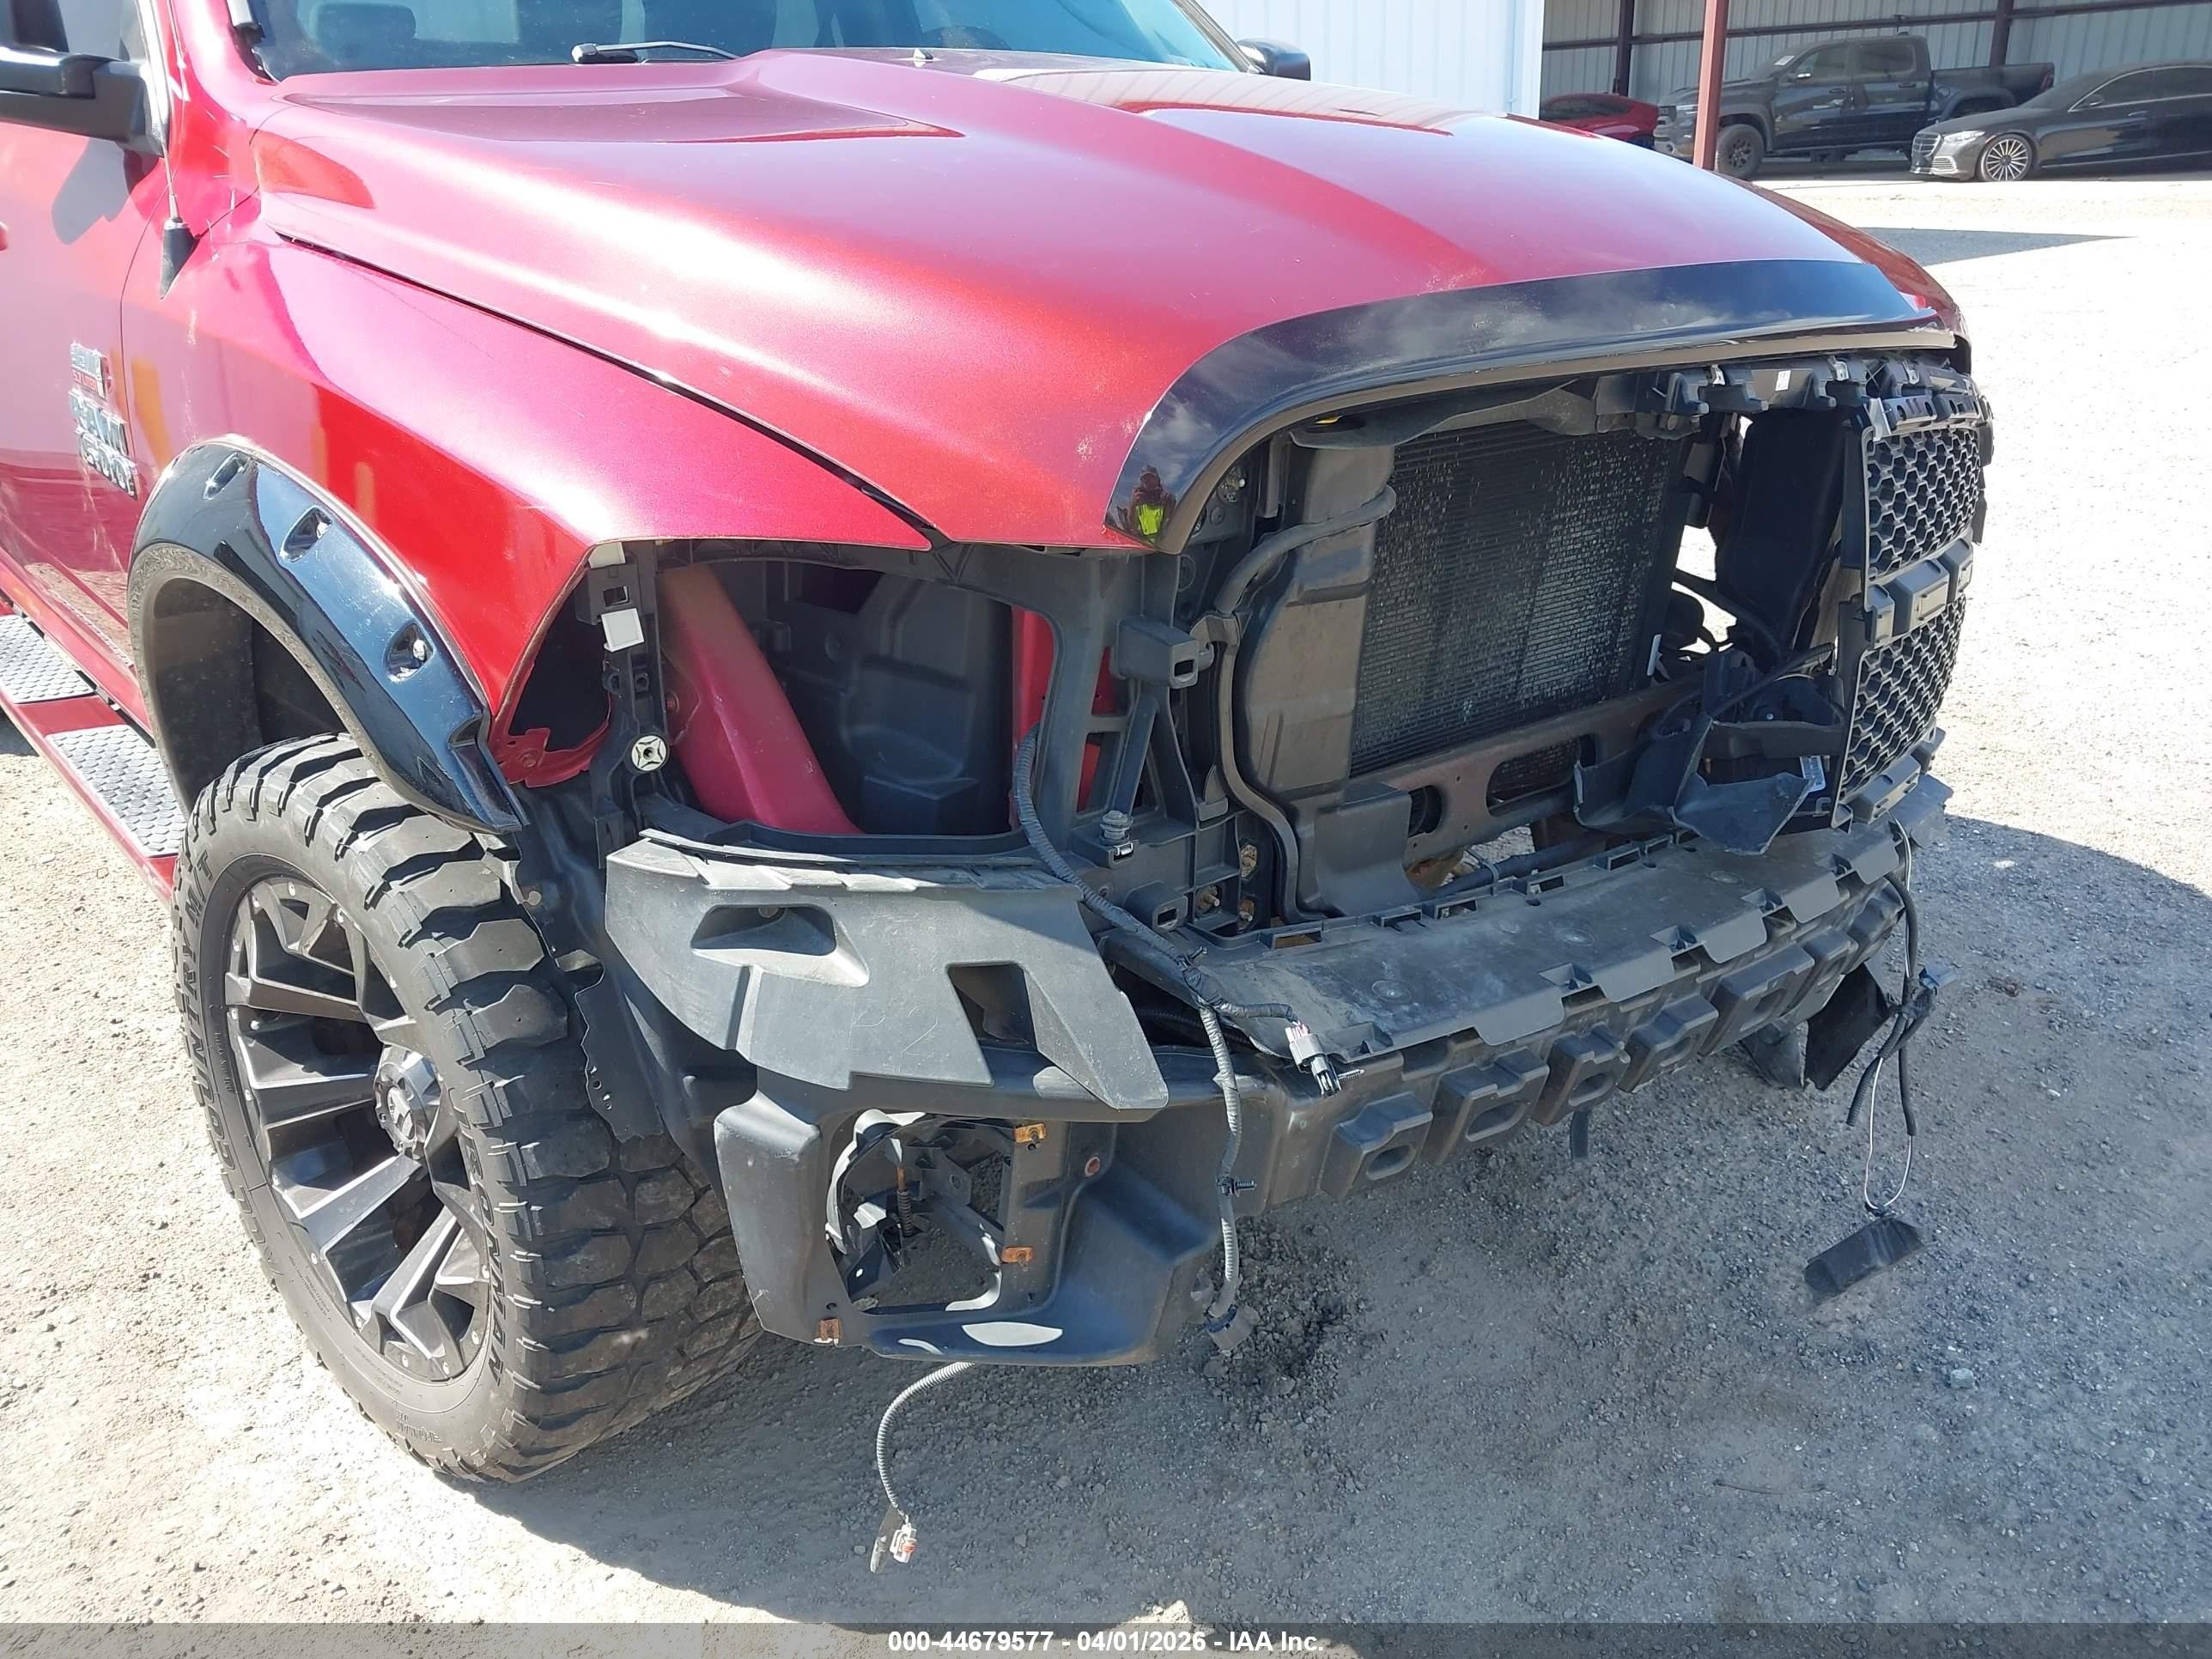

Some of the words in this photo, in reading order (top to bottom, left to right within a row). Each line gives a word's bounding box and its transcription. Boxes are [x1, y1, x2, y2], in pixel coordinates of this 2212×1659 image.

[184, 848, 214, 929] M/T
[181, 927, 234, 1170] COUNTRY
[450, 1095, 507, 1387] IRONMAN
